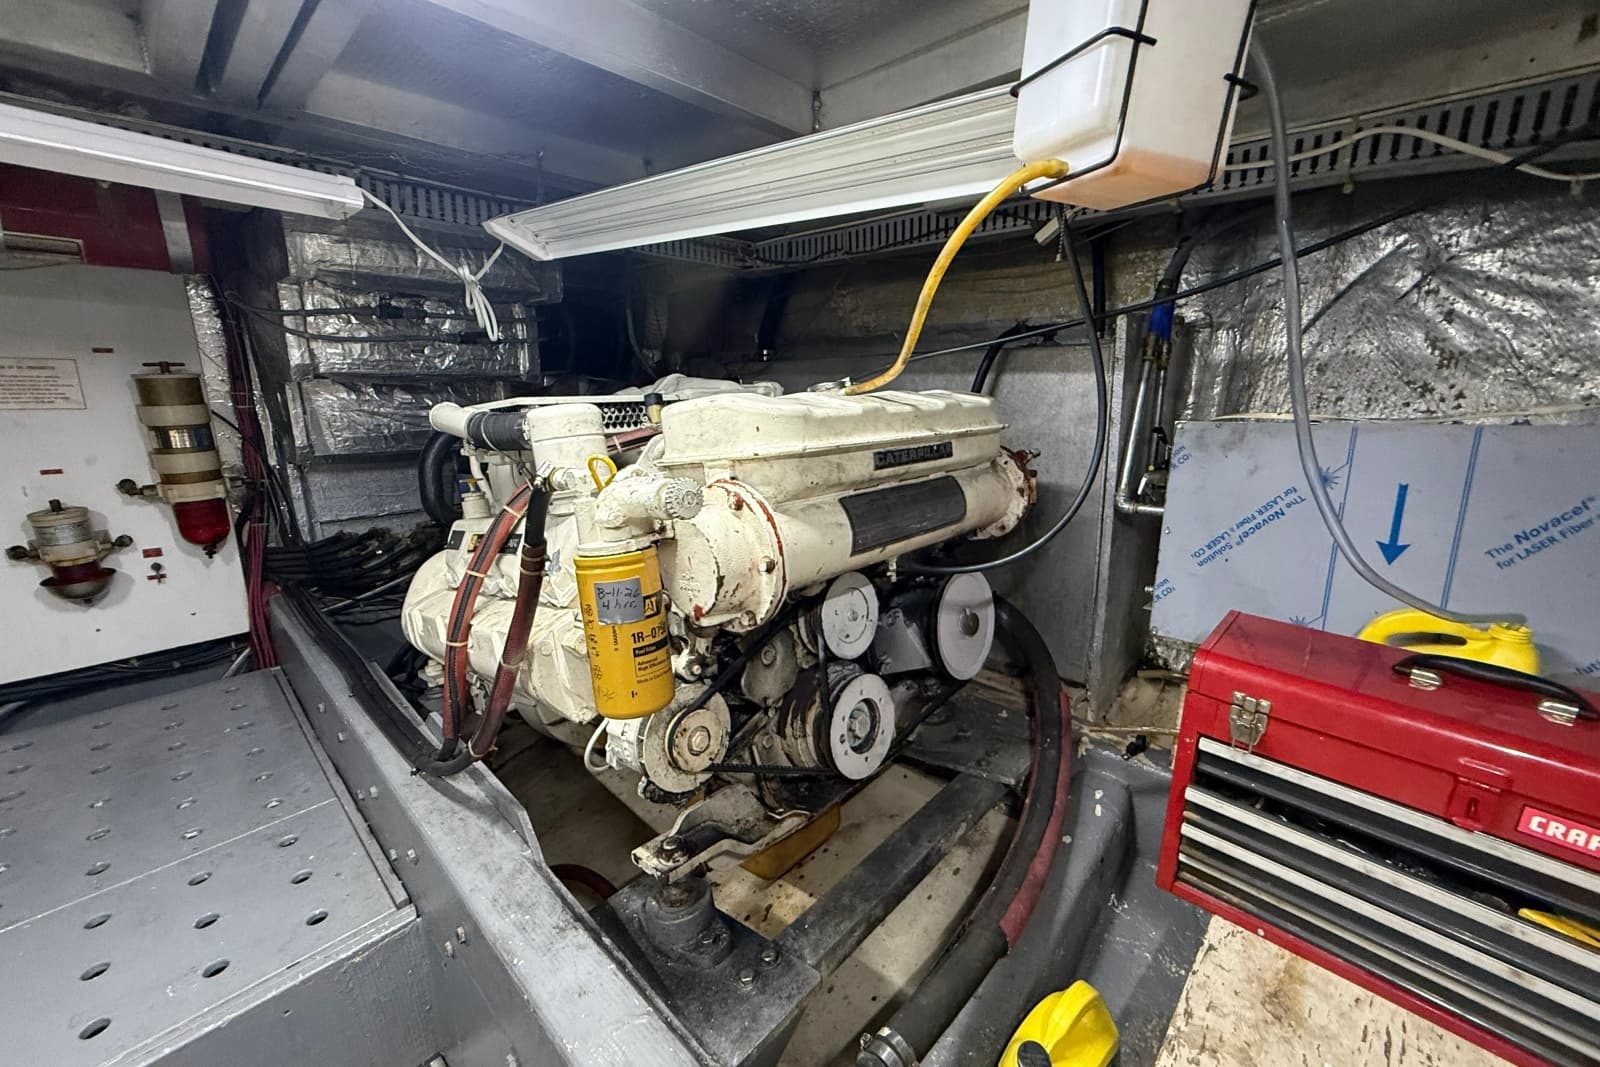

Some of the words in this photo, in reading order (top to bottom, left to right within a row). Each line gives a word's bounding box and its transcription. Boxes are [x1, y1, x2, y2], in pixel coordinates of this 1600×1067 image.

[876, 443, 952, 466] CATERPILLAR
[1283, 486, 1298, 497] for
[1256, 495, 1285, 516] LASER
[1285, 495, 1307, 509] The
[1235, 513, 1257, 530] Fiber
[1205, 531, 1231, 551] LASER
[1484, 543, 1514, 559] The
[1496, 557, 1515, 570] for
[1515, 535, 1559, 560] LASER
[1558, 517, 1594, 539] Fiber
[1197, 542, 1233, 567] Solution
[602, 600, 609, 610] 4
[1528, 815, 1600, 851] CRAF
